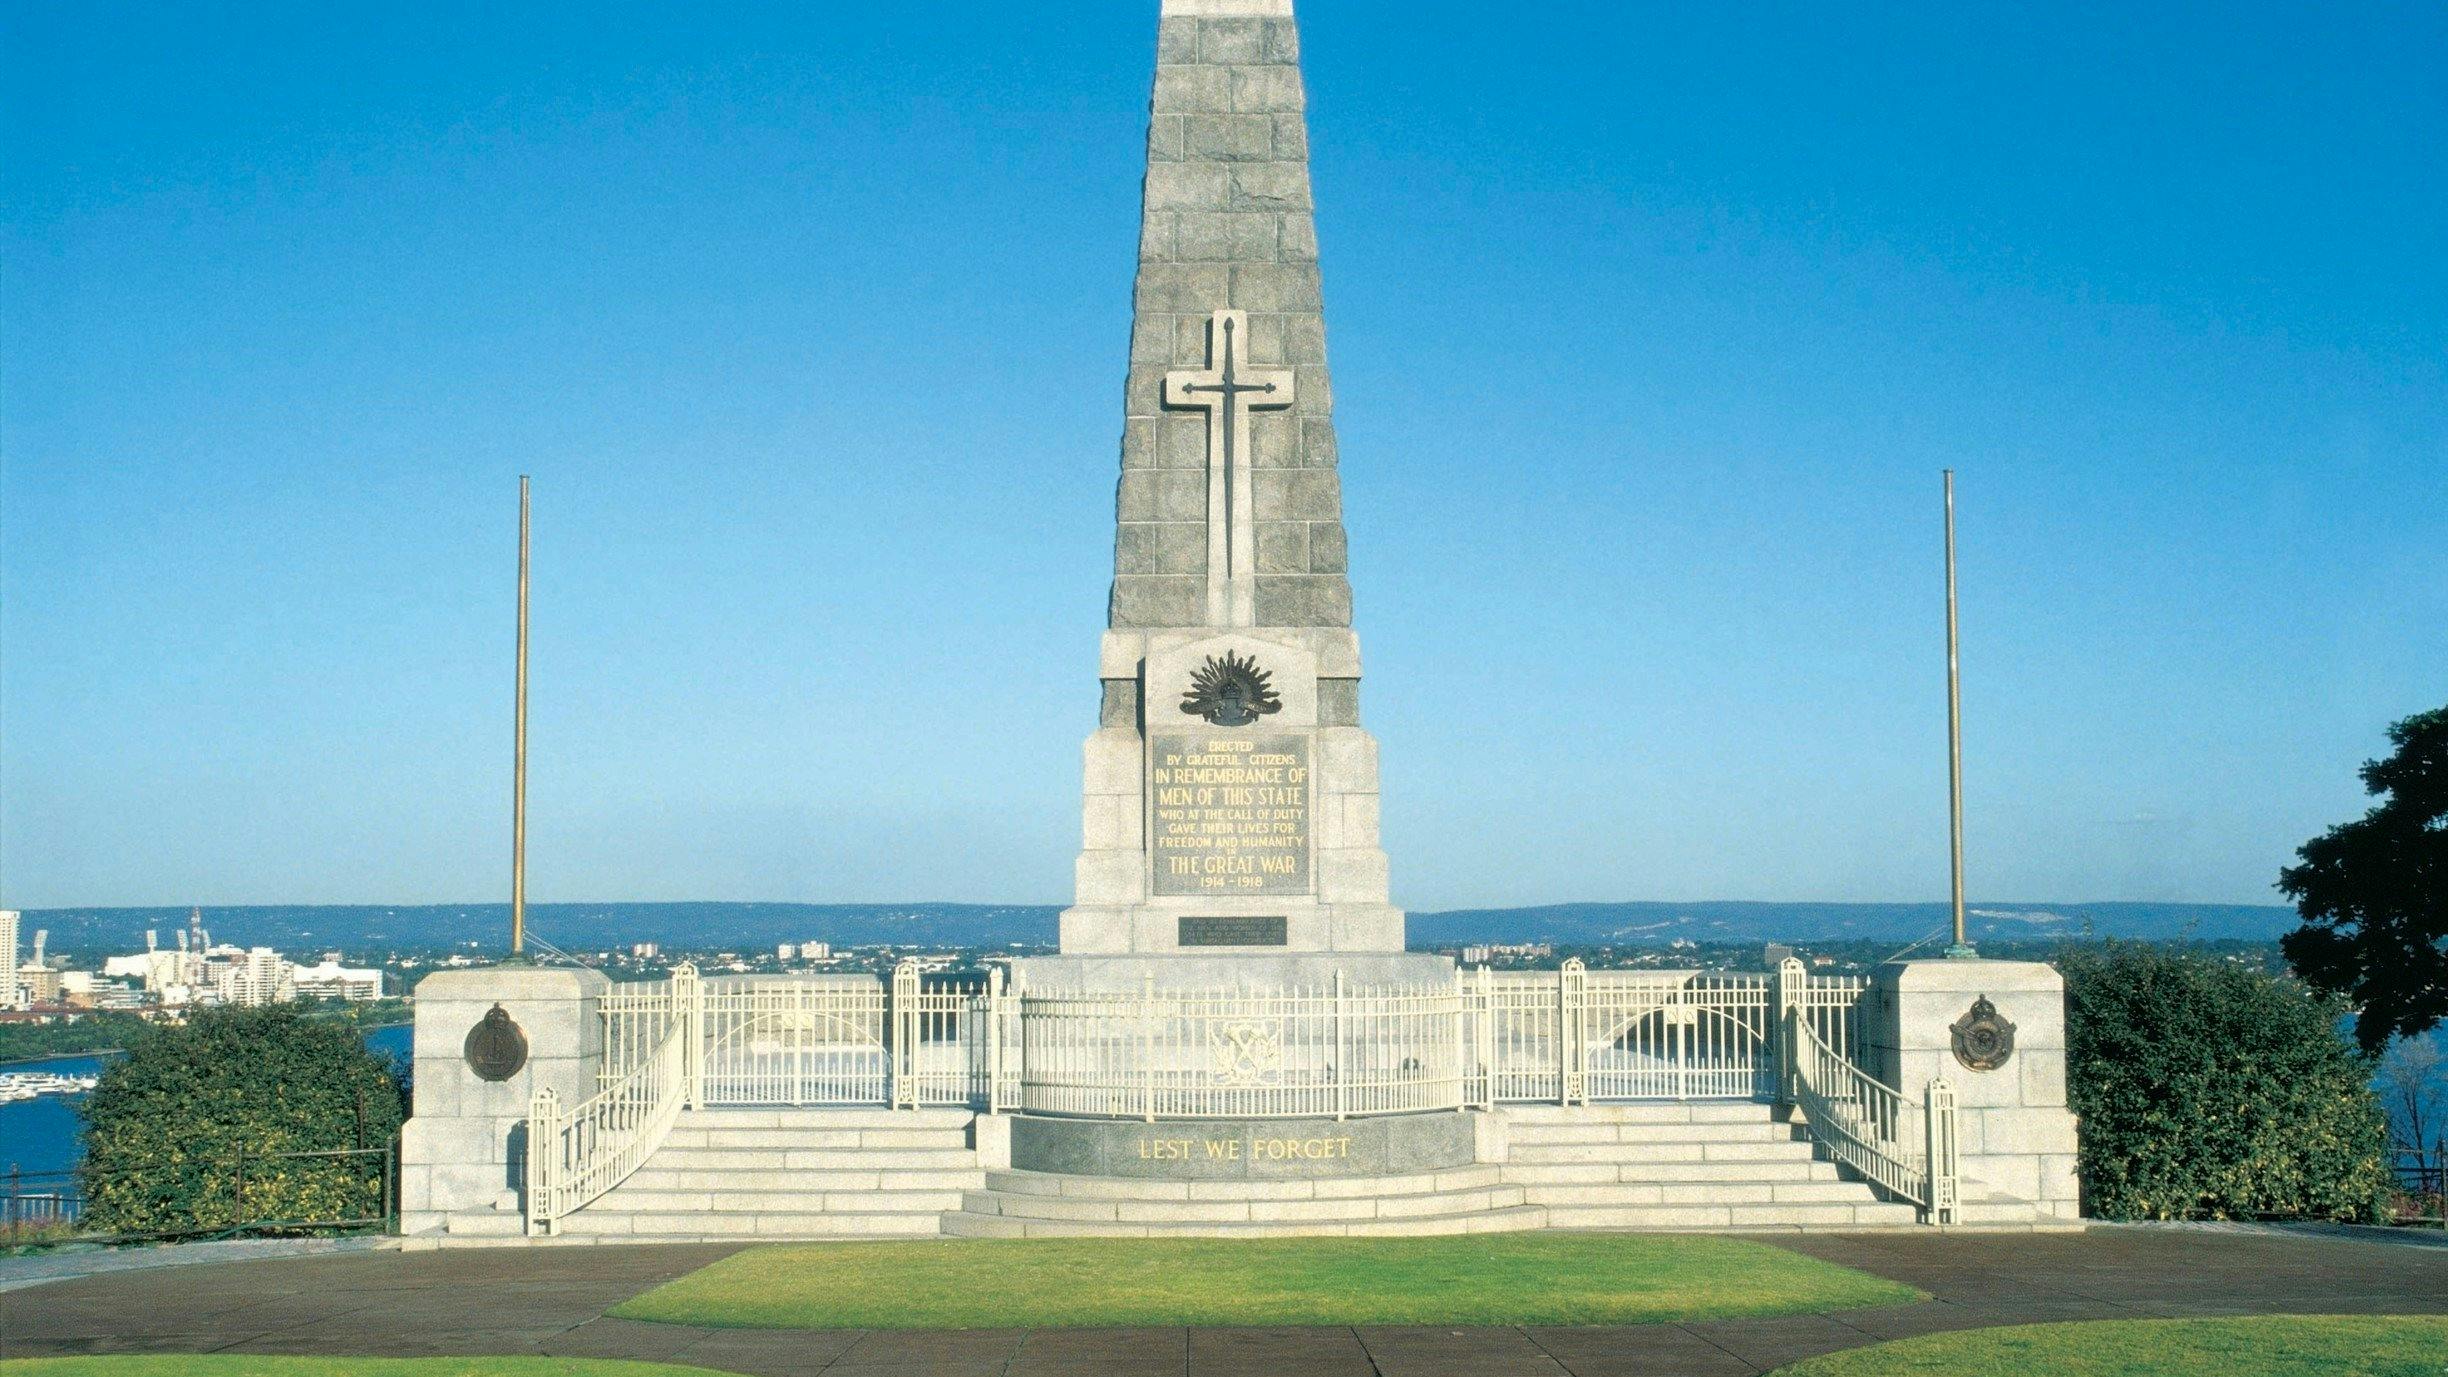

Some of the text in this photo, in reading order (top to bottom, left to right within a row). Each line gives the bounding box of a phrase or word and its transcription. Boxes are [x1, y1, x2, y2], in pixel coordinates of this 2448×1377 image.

[1208, 741, 1254, 752] ERECTED
[1167, 754, 1296, 766] BY GRATEFUL CITIZENS
[1155, 768, 1307, 784] IN REMEMBRANCE OF
[1159, 788, 1303, 805] MEN OF THIS STATE
[1159, 809, 1304, 820] WHO AT THE CALL OF DUTY
[1168, 823, 1296, 834] GAVE THEIR LIVES FOR
[1158, 837, 1304, 848] FREEDOM AND HUMANITY
[1169, 856, 1296, 874] THE GREAT WAR
[1200, 876, 1224, 888] 1914
[1237, 876, 1263, 888] 1918
[1139, 1138, 1351, 1160] LEST WE FORGET
